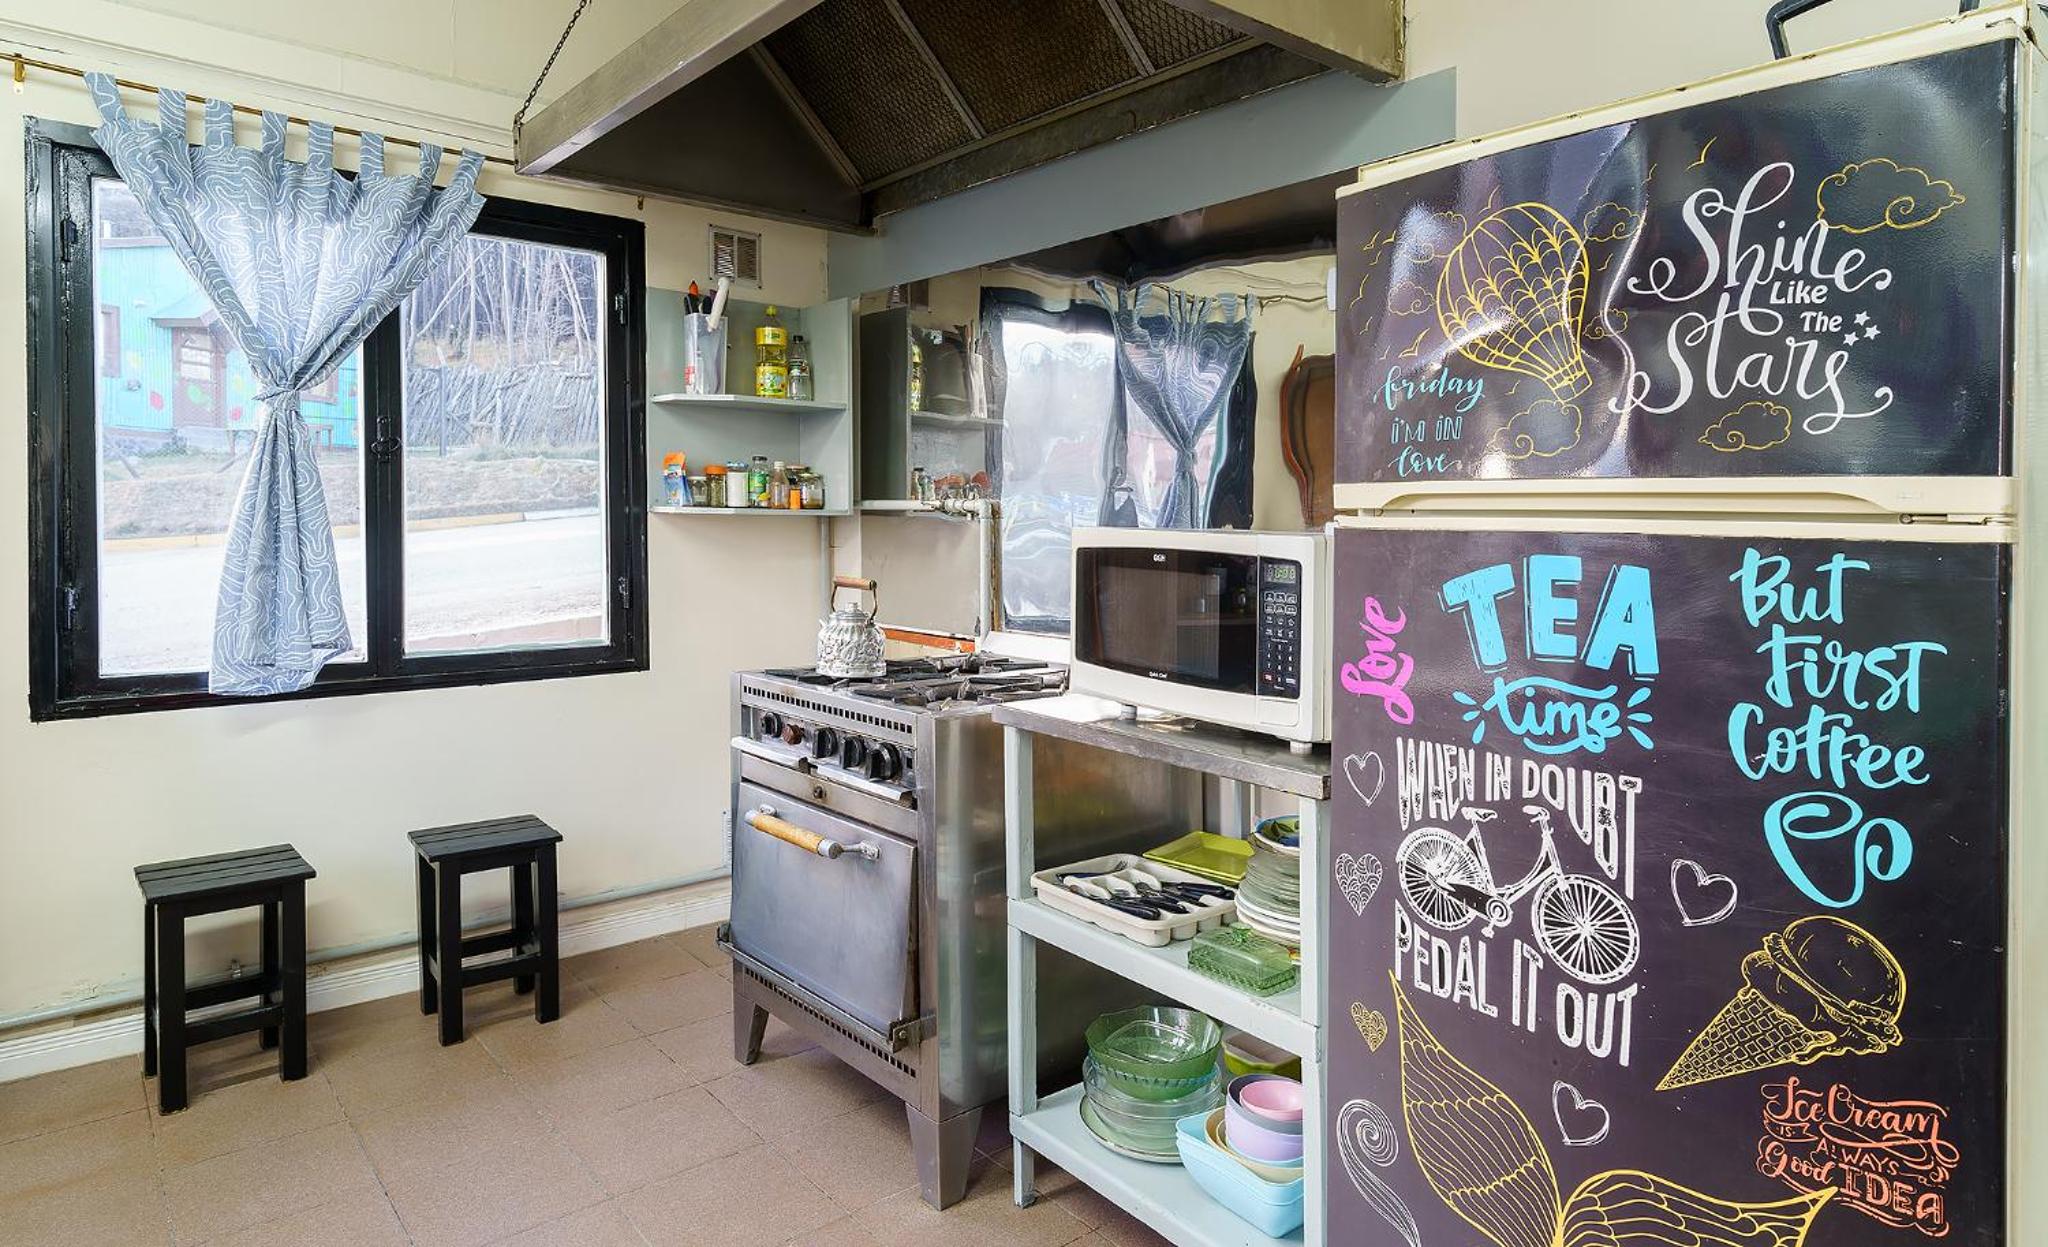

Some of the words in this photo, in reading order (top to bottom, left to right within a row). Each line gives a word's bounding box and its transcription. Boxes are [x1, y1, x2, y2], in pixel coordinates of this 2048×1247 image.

[1627, 162, 1892, 335] Shine
[1769, 281, 1828, 304] Like
[1800, 311, 1842, 332] The
[1608, 292, 1893, 434] Stars
[1438, 554, 1659, 681] TEA
[1729, 548, 1870, 627] But
[1341, 596, 1414, 725] Love
[1483, 676, 1622, 754] time
[1728, 702, 1930, 789] Coffee
[1396, 736, 1475, 831] WHEN
[1485, 751, 1511, 801] IN
[1522, 759, 1642, 900] DOUBT
[1395, 899, 1498, 1018] PEDAL
[1512, 938, 1543, 1032] IT
[1556, 982, 1638, 1067] OUT
[1761, 1076, 1825, 1122] Ice
[1828, 1083, 1947, 1145] Cream
[1761, 1140, 1835, 1185] Good
[1838, 1163, 1944, 1225] IDEA
[1816, 1138, 1900, 1176] ALWAYS
